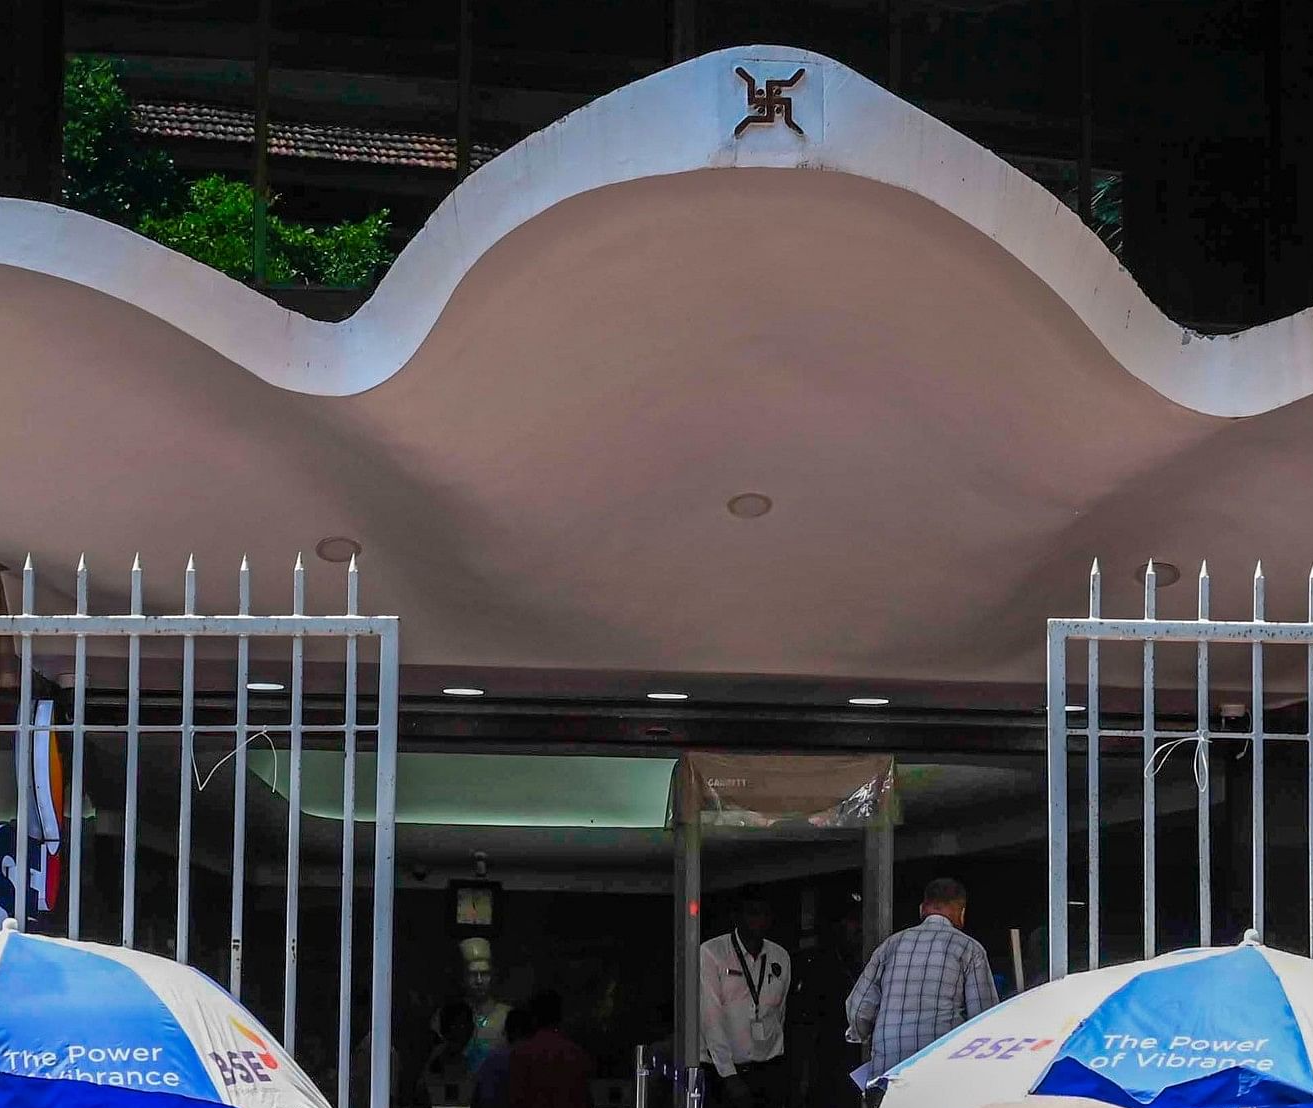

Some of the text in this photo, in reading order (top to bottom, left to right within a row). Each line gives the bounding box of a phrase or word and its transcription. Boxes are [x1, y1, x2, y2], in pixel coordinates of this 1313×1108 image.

[948, 1037, 1037, 1060] BSE
[1102, 1034, 1270, 1053] The Power
[5, 1045, 163, 1071] The Power
[1089, 1052, 1124, 1070] of
